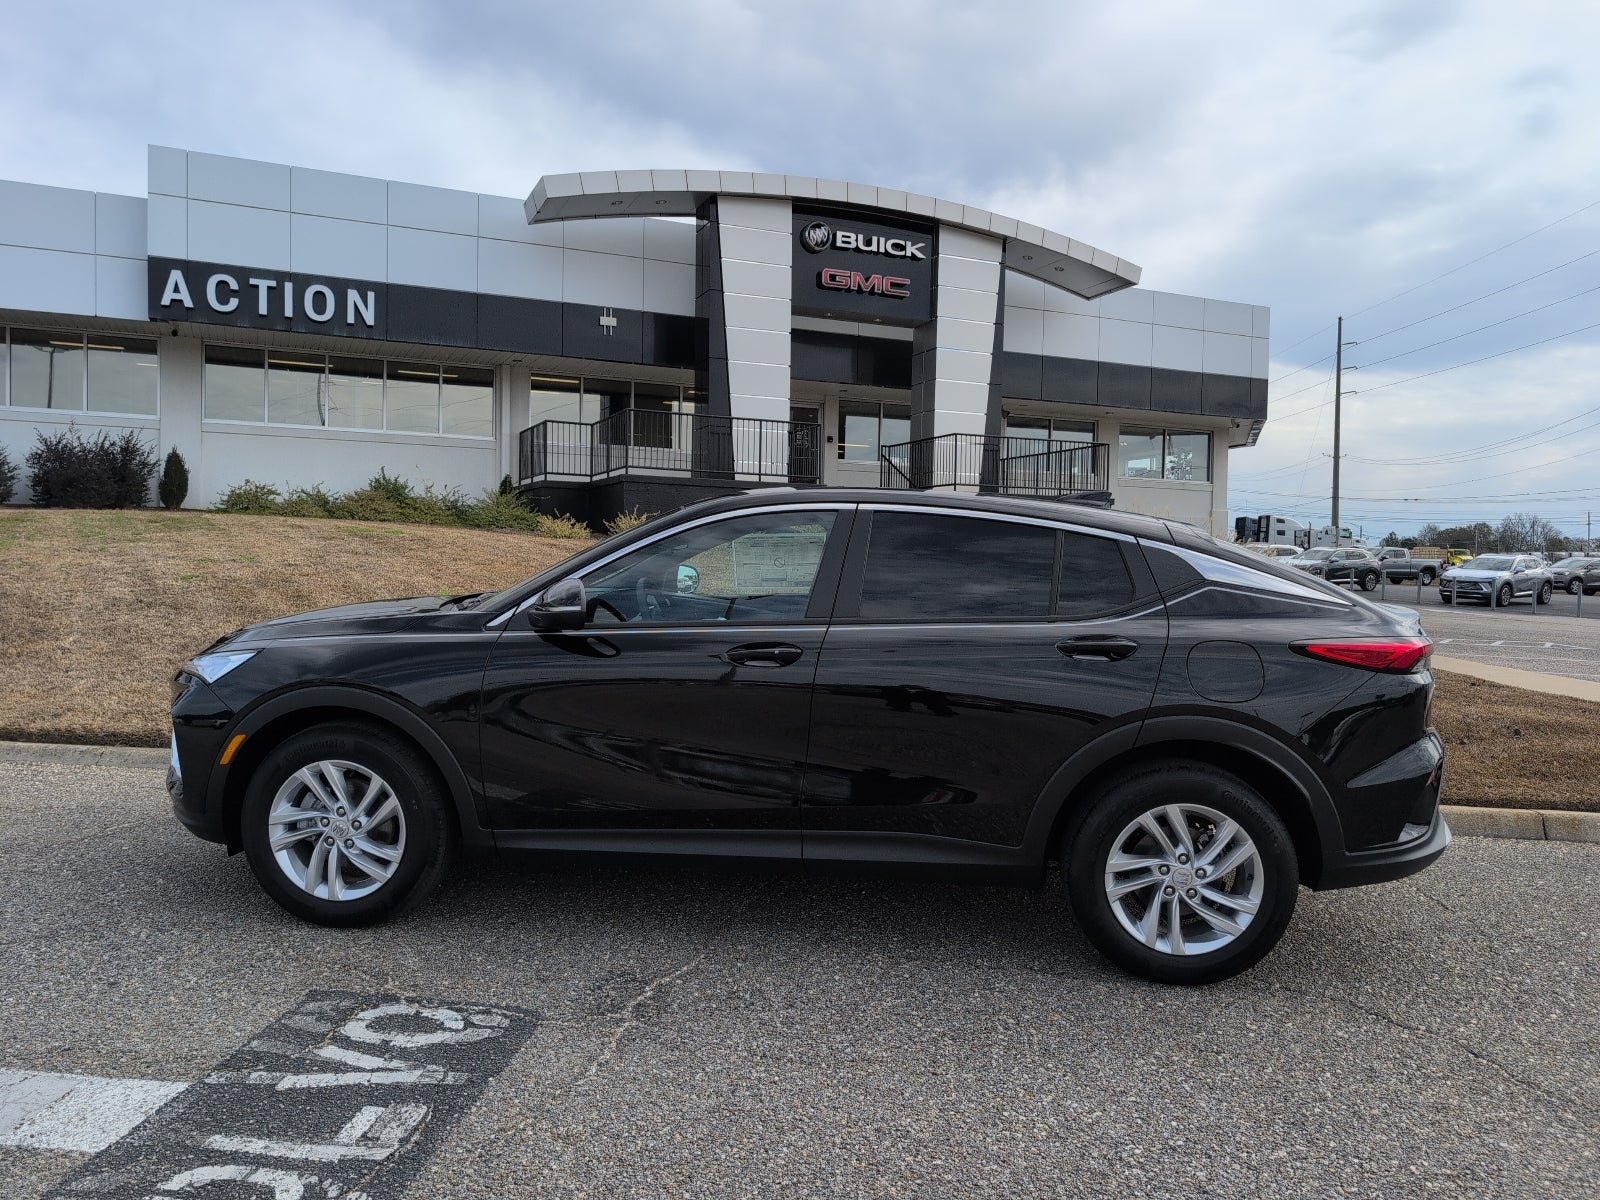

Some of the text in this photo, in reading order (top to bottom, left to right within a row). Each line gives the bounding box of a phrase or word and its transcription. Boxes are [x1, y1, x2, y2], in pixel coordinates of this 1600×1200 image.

[836, 230, 927, 259] BUICK
[822, 267, 911, 297] GMC
[160, 269, 375, 326] ACTION
